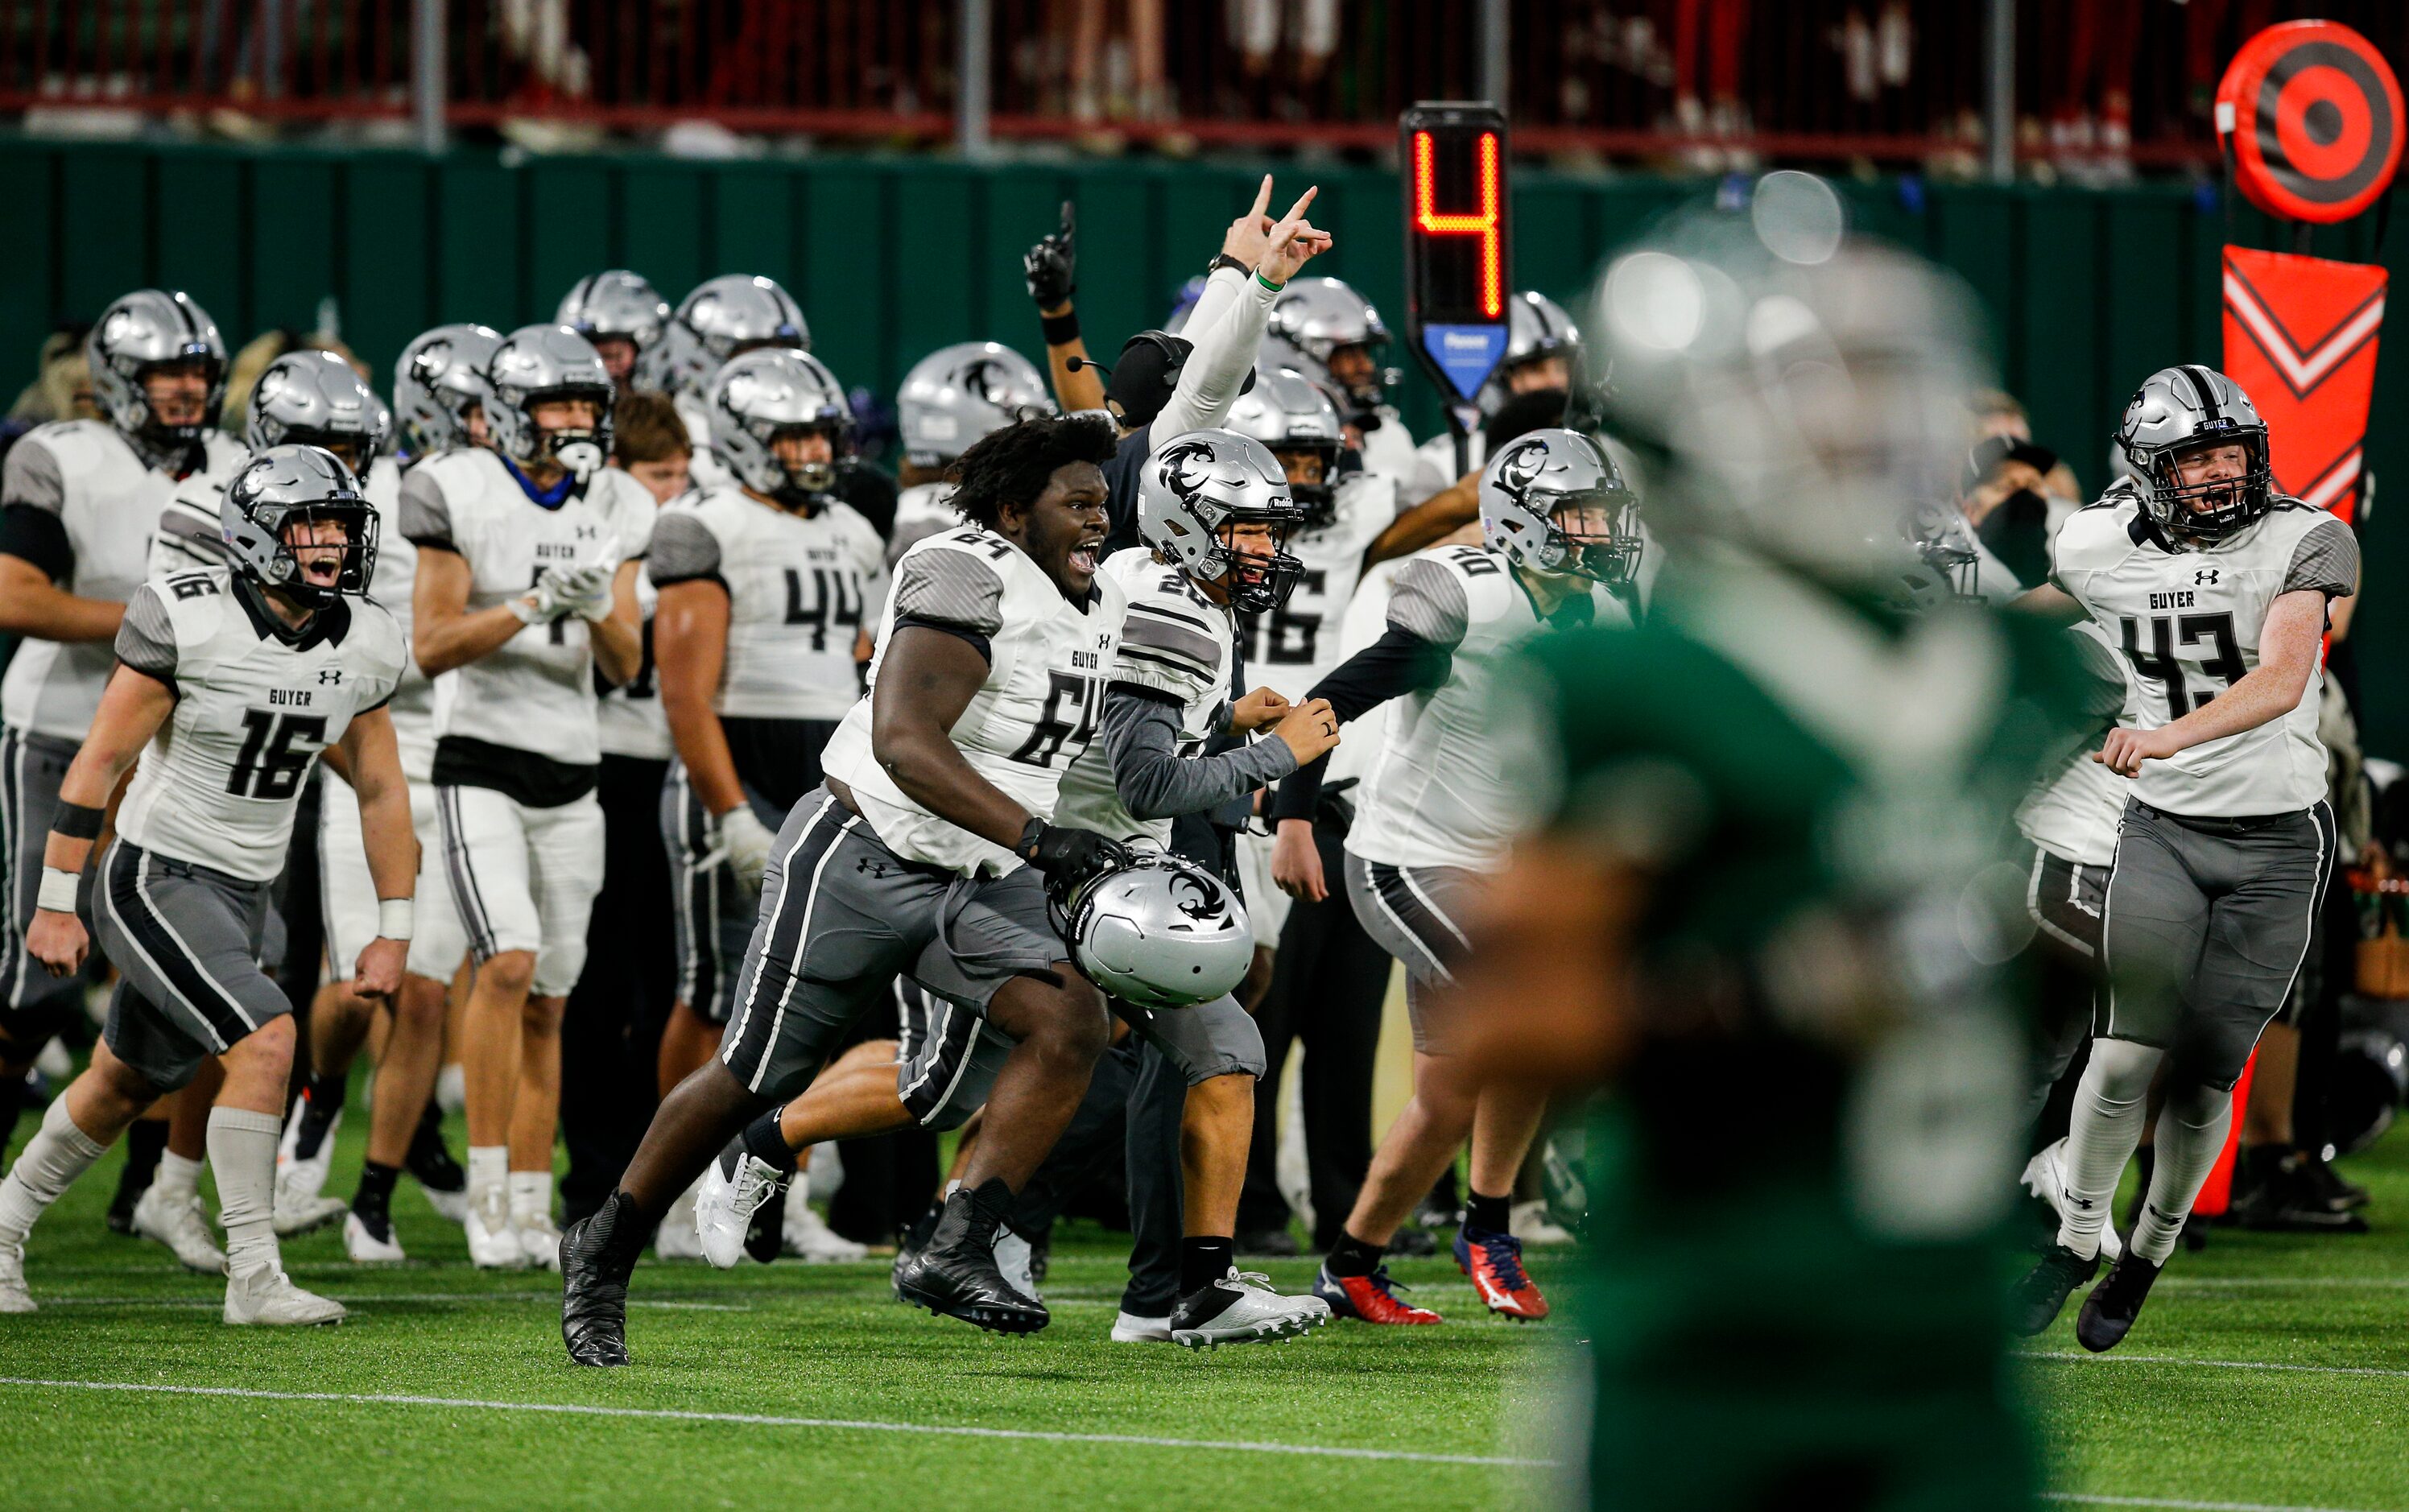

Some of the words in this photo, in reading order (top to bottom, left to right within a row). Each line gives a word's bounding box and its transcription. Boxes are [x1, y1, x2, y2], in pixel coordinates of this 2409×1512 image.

[1415, 131, 1500, 316] 4
[2203, 419, 2228, 431] GUYER
[950, 532, 1016, 561] 64
[165, 572, 221, 603] 16
[2149, 590, 2196, 609] GUYER
[784, 568, 863, 651] 44
[1072, 650, 1098, 670] GUYER
[2119, 610, 2249, 721] 43
[270, 688, 312, 706] GUYER
[1008, 668, 1106, 770] 64
[225, 706, 328, 799] 16
